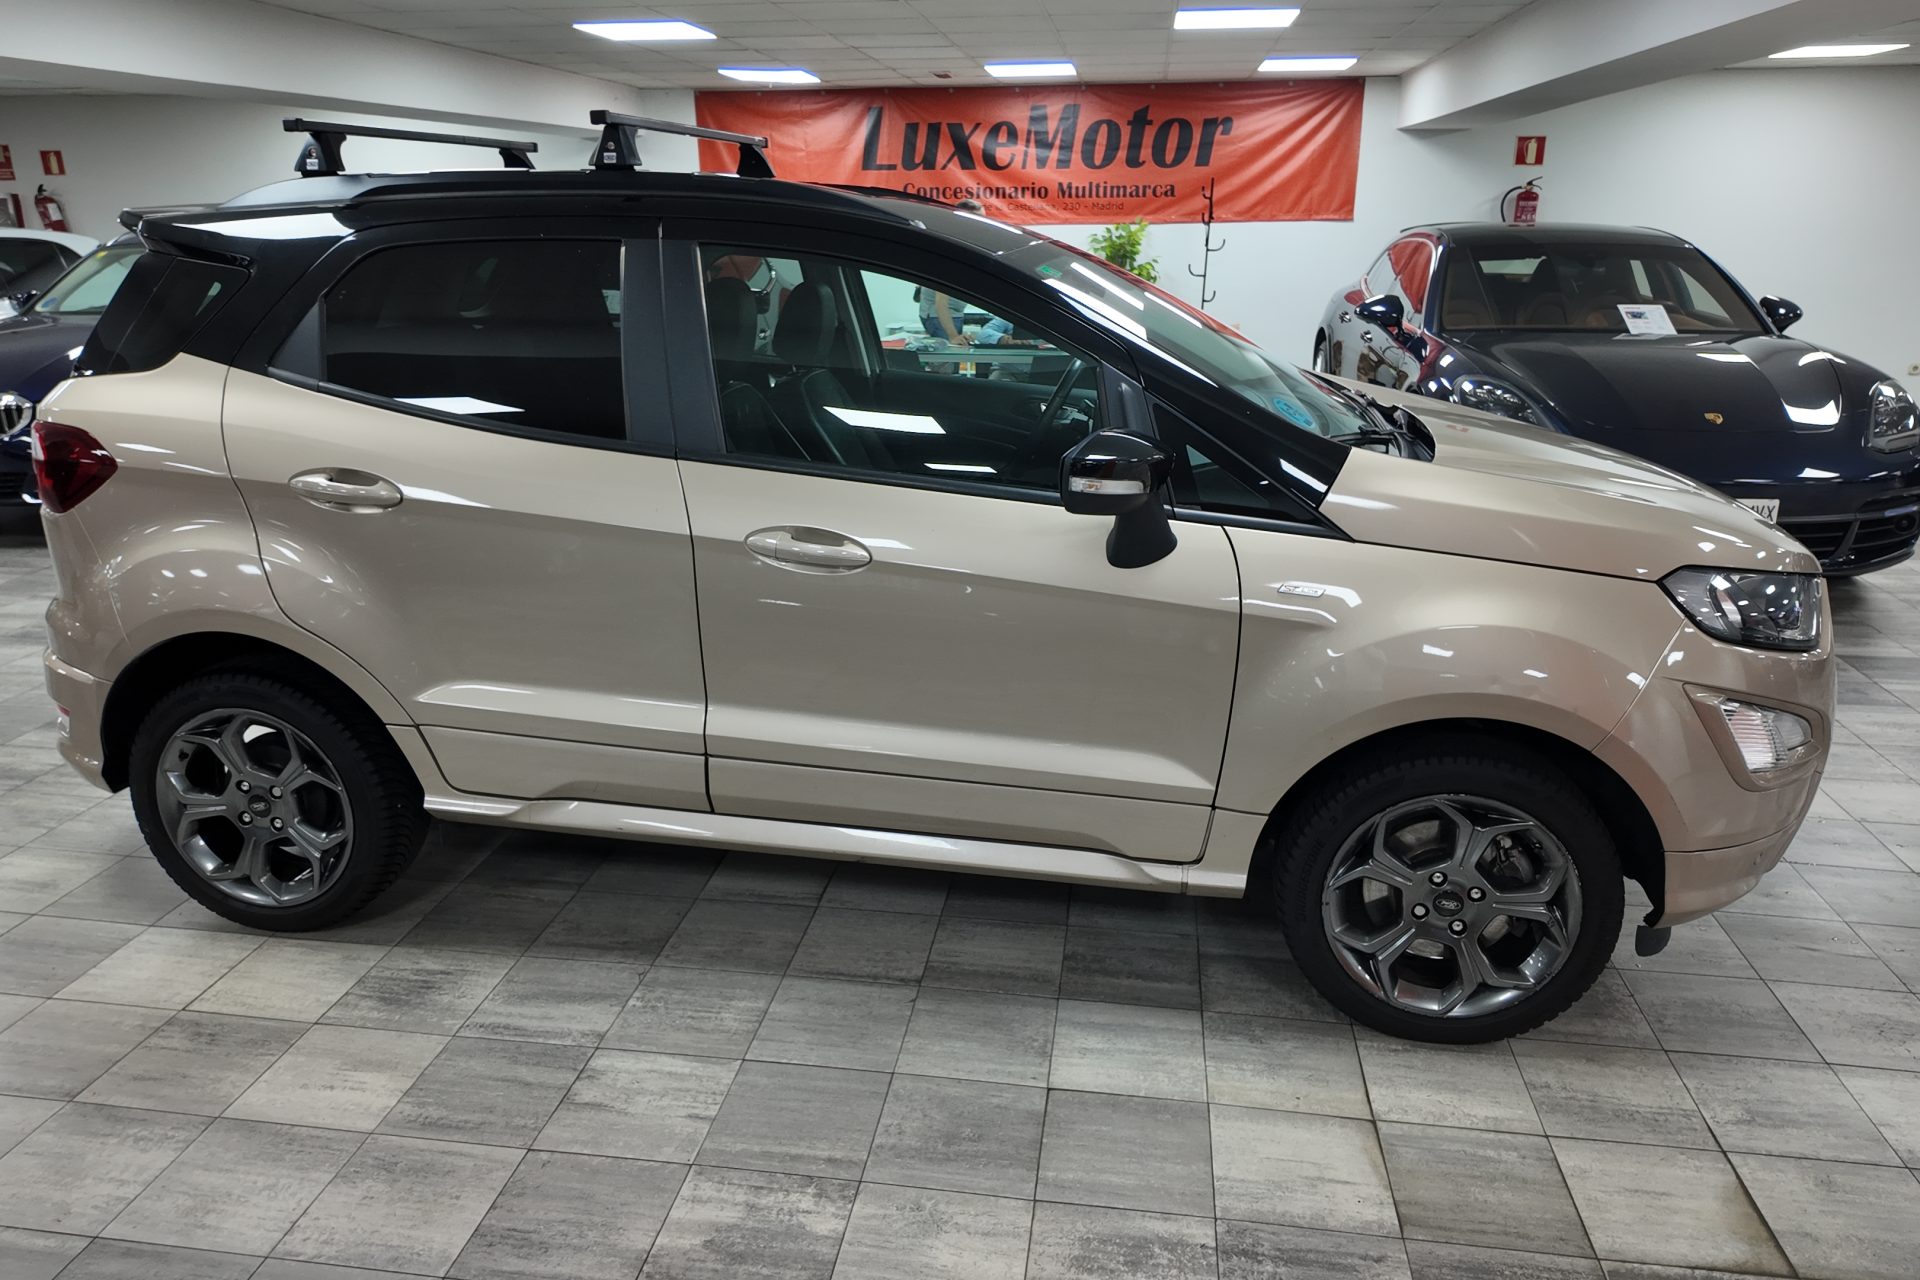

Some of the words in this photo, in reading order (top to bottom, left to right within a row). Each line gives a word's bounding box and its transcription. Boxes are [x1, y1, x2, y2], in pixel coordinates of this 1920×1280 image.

[862, 104, 1233, 171] LuxeMotor
[903, 182, 1049, 200] Concesionario
[1057, 181, 1176, 199] Multimarca
[1062, 202, 1081, 211] 230
[1091, 201, 1125, 211] Madrid
